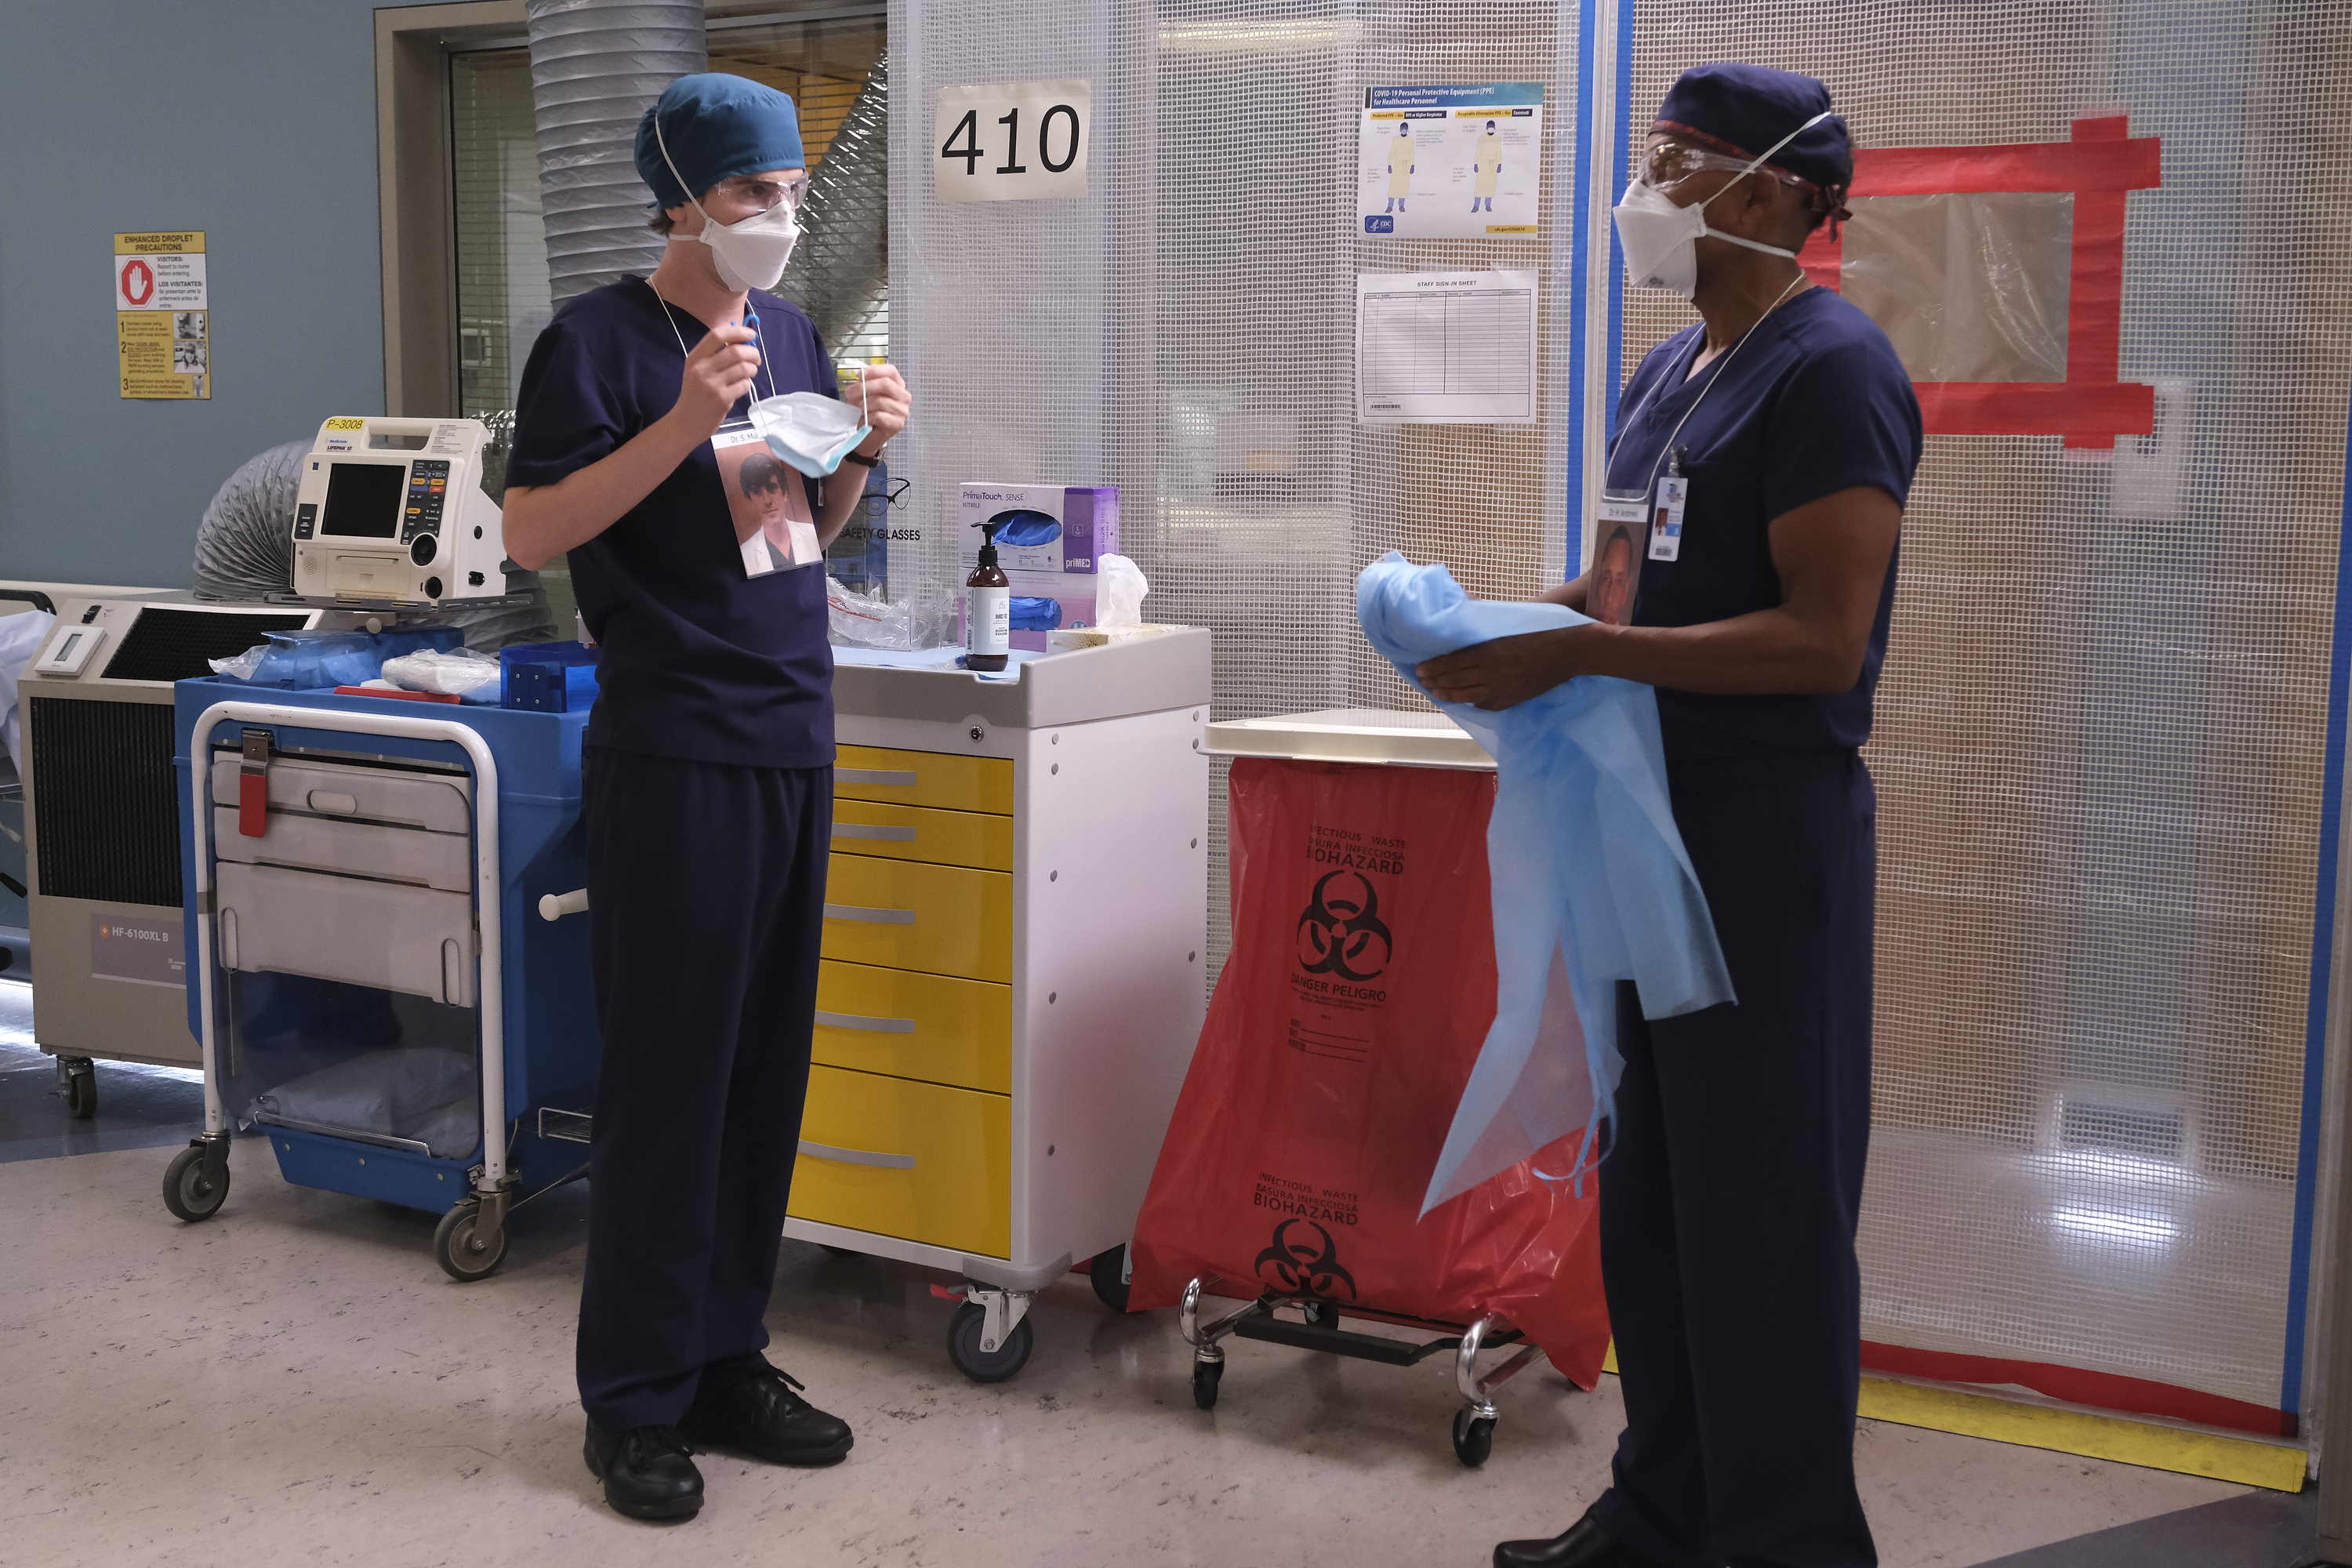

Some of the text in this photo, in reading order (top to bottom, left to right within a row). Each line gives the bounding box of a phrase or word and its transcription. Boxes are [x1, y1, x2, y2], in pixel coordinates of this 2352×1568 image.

[1450, 88, 1479, 97] Equipment
[942, 104, 1080, 176] 410
[121, 321, 124, 332] 1
[122, 342, 126, 353] 2
[123, 379, 129, 390] 3
[327, 419, 363, 429] P-3008
[839, 528, 920, 541] SAFETY GLASSES
[1372, 836, 1406, 848] WASTE
[1345, 844, 1405, 861] INFECCIOSA
[112, 927, 169, 942] HF-6100XL B
[1291, 972, 1329, 993] DANGER
[1333, 984, 1386, 1002] PELIGRO
[1259, 1172, 1359, 1201] INFECTIOUS WASTE
[1256, 1183, 1358, 1213] BASURA INFECCIOSA
[1254, 1192, 1358, 1225] BIOHAZARD
